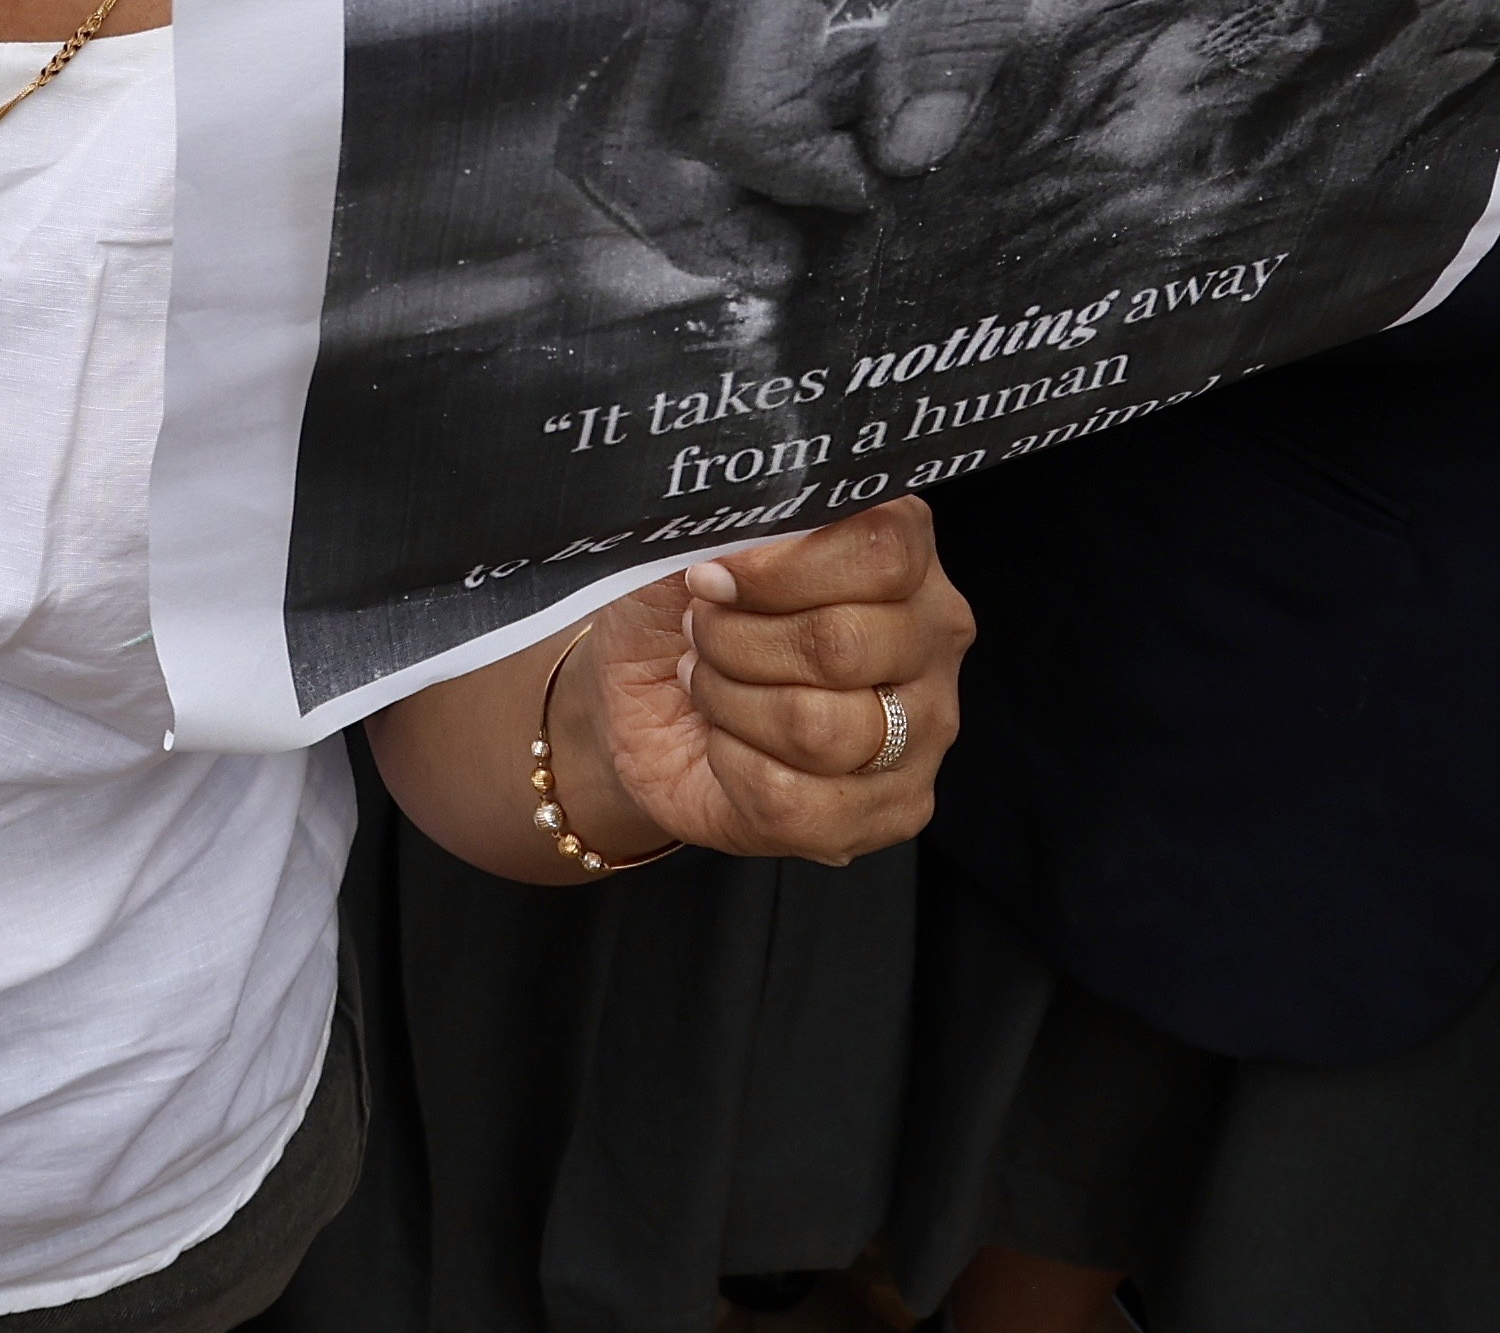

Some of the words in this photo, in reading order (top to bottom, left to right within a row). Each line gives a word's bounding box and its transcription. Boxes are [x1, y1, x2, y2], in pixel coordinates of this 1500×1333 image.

[544, 403, 633, 457] “It
[648, 361, 830, 438] takes
[843, 290, 1120, 399] nothing
[1124, 243, 1289, 333] away
[661, 436, 830, 501] from
[851, 418, 887, 455] a
[900, 353, 1130, 443] human
[463, 551, 528, 593] to
[542, 528, 635, 566] be
[642, 486, 822, 546] kind
[825, 470, 889, 510] to
[905, 446, 987, 490] an
